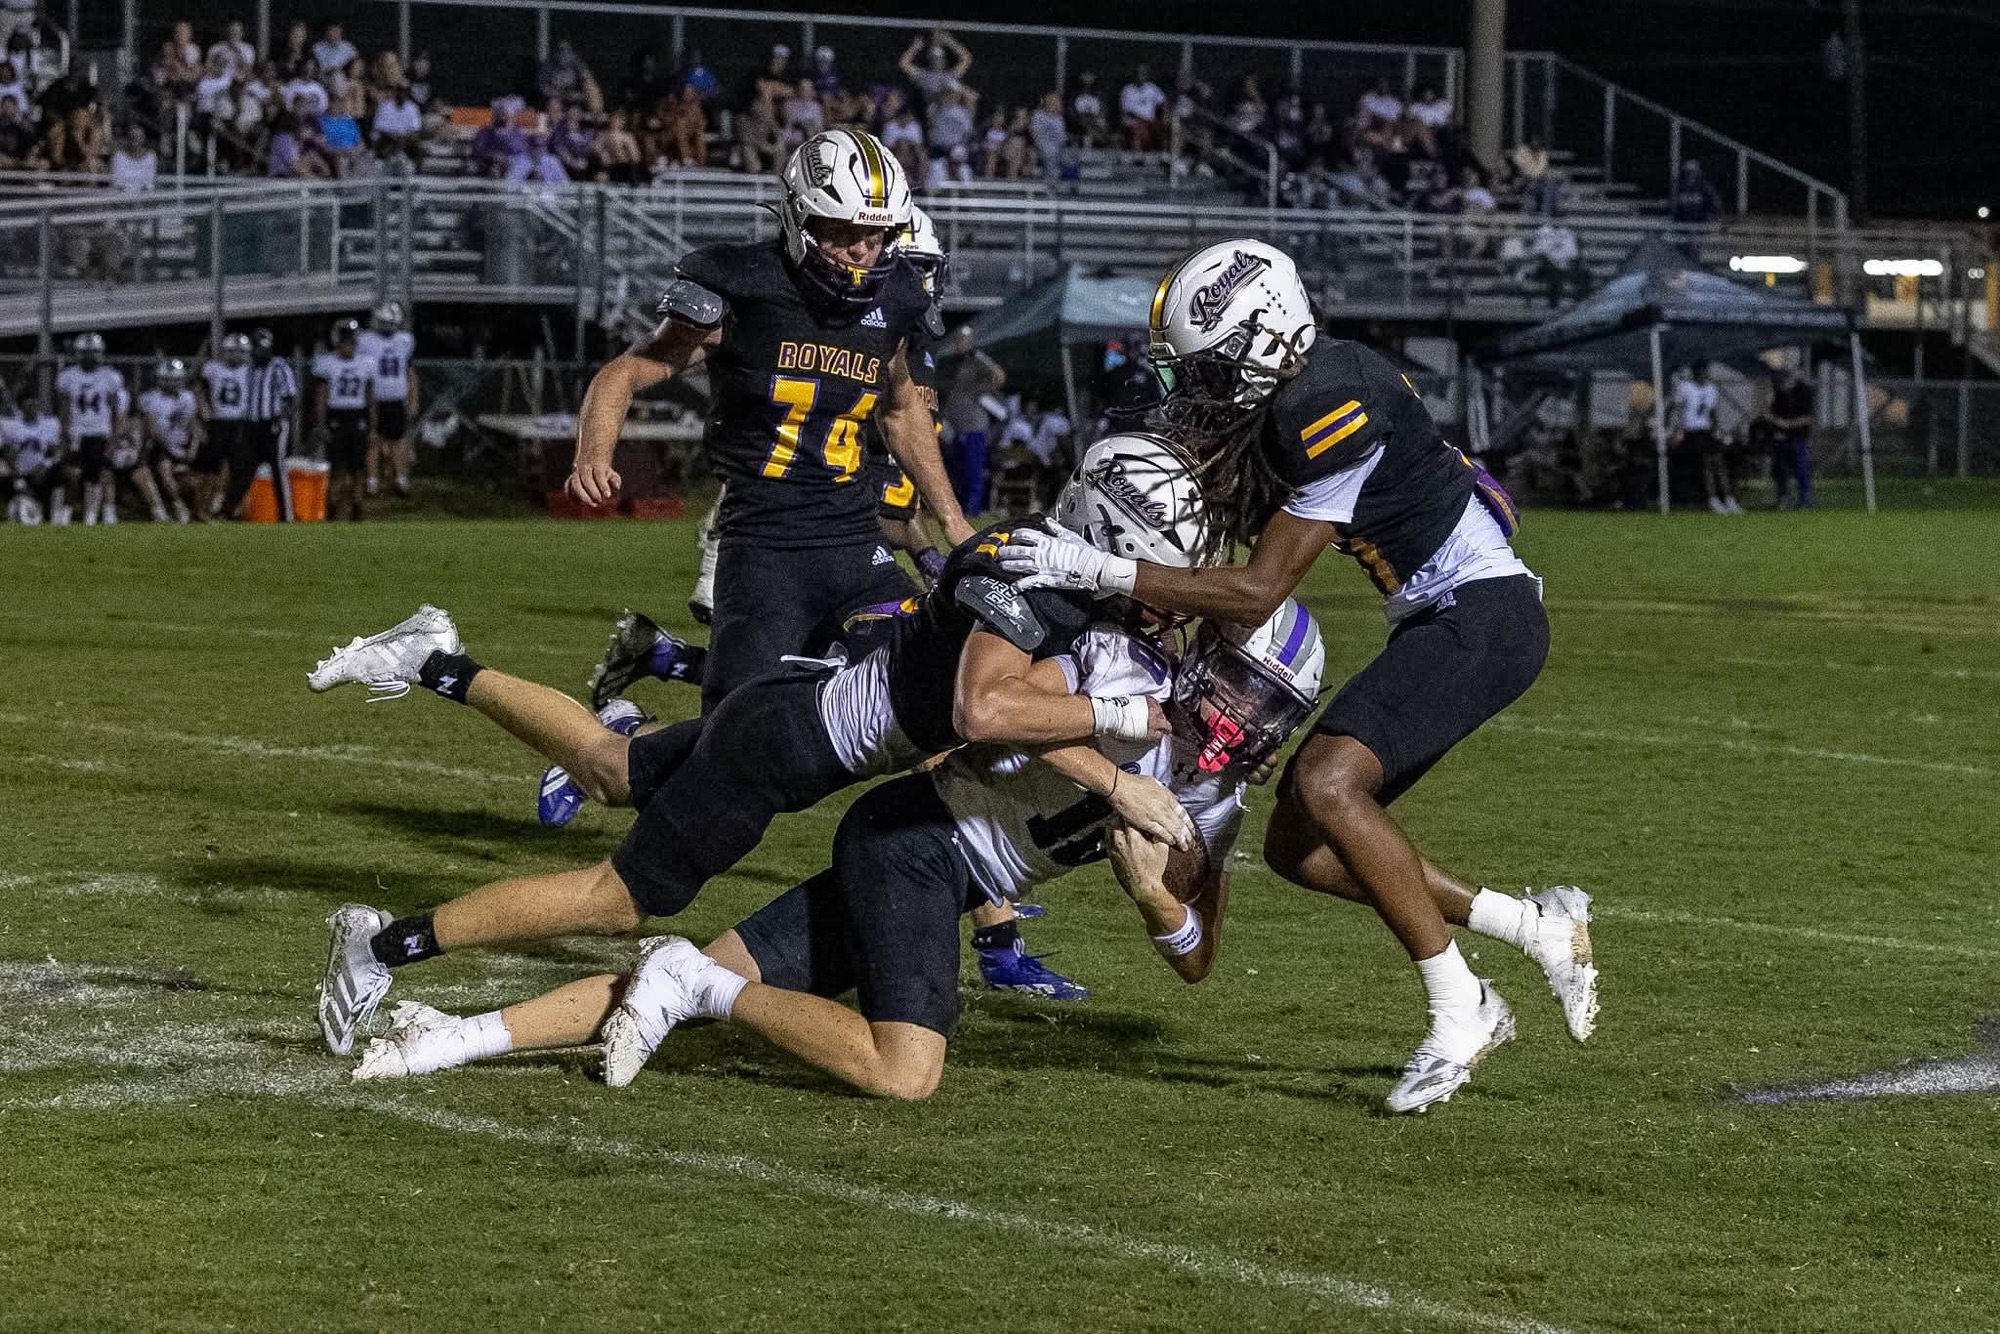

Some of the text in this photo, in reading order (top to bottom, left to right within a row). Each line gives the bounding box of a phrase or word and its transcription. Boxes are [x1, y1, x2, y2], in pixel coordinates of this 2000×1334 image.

[858, 211, 893, 222] Riddell
[1189, 249, 1263, 328] Royals
[778, 342, 880, 384] ROYALS
[760, 375, 882, 483] 74
[1086, 458, 1167, 528] Royals
